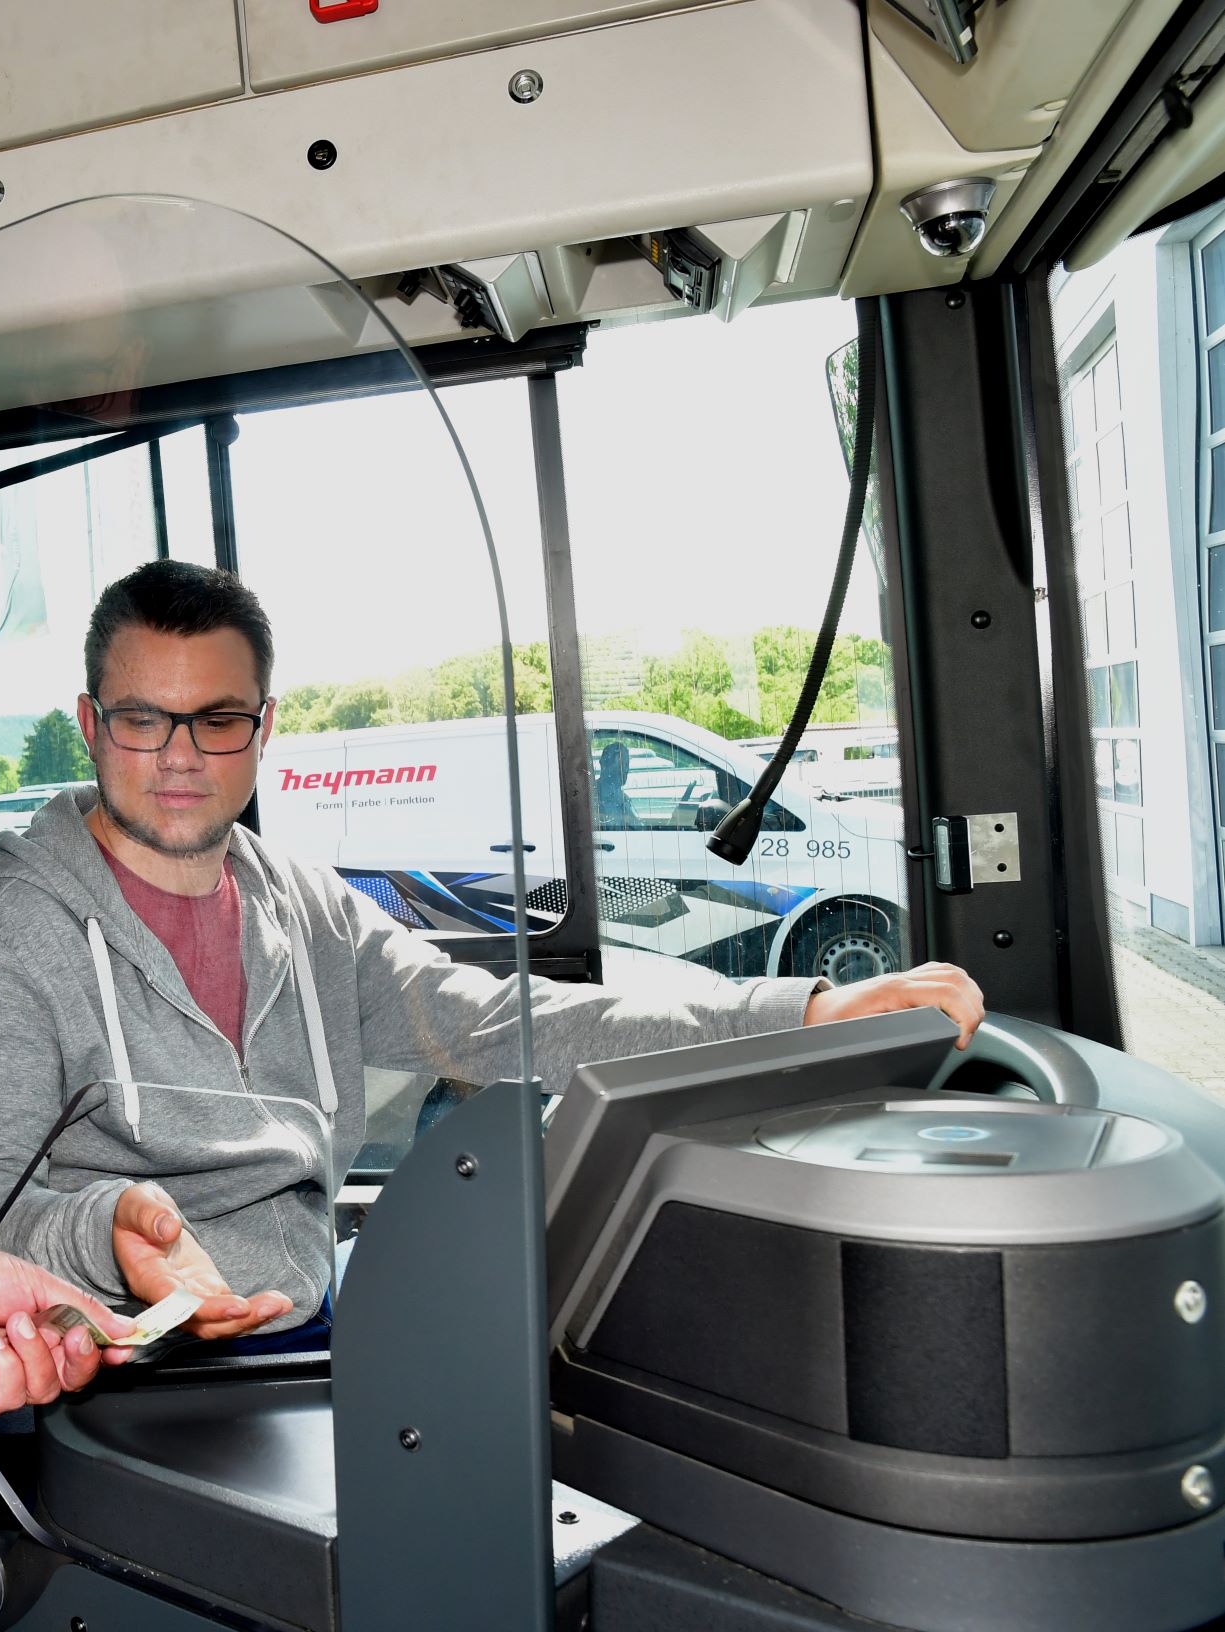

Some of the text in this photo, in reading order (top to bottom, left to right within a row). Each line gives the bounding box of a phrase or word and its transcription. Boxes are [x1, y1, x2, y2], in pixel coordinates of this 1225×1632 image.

[278, 765, 437, 795] heymann
[316, 795, 435, 811] Form Farbe Funktion
[760, 838, 851, 859] 28 985
